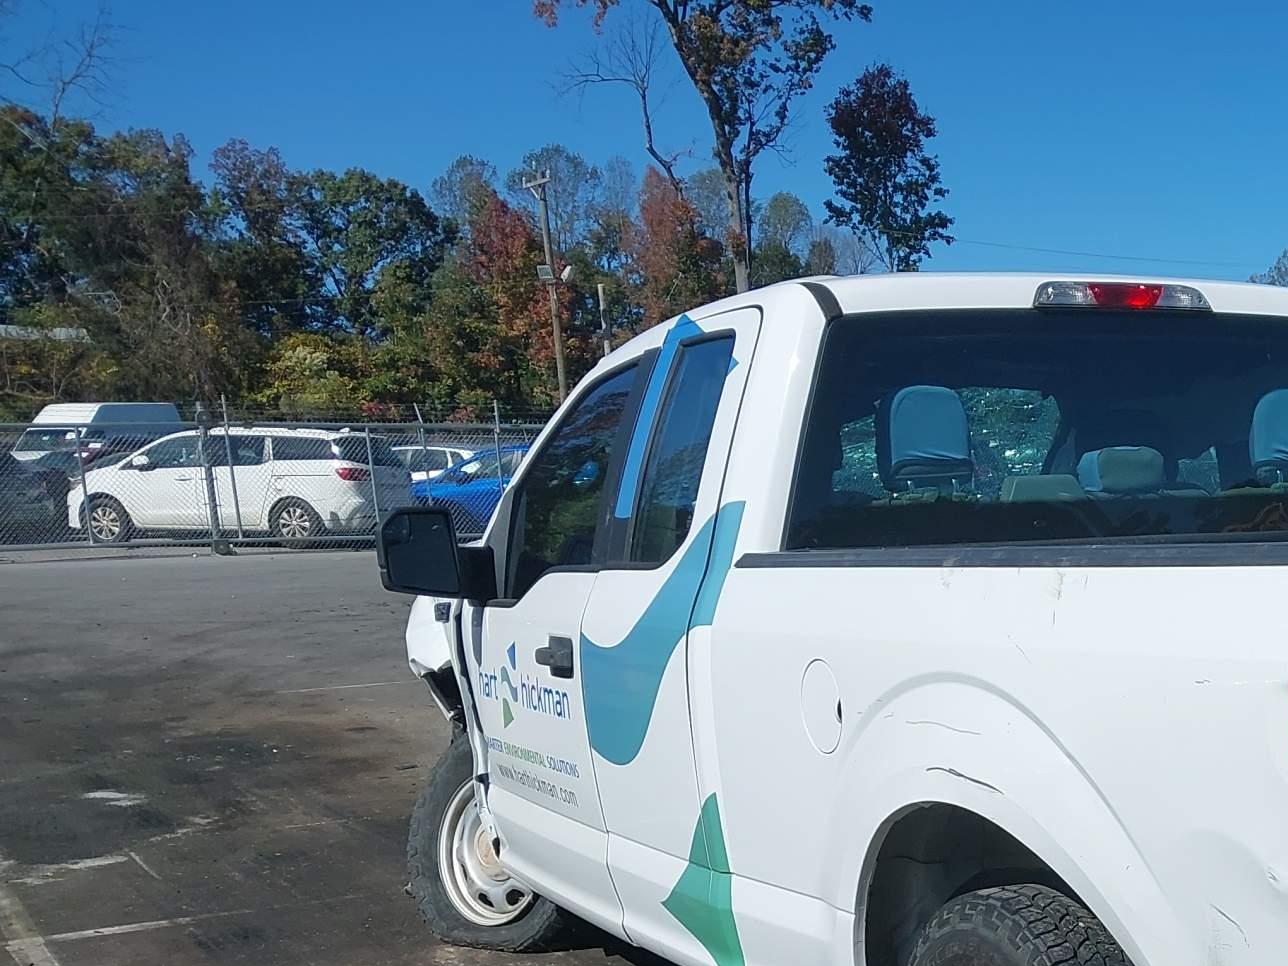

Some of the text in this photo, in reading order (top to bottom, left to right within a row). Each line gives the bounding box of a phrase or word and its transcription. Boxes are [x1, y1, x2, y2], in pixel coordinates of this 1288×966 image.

[520, 672, 571, 720] hickman
[503, 741, 547, 768] ENVIRONMENTAL
[546, 755, 580, 779] SOLUTIONS
